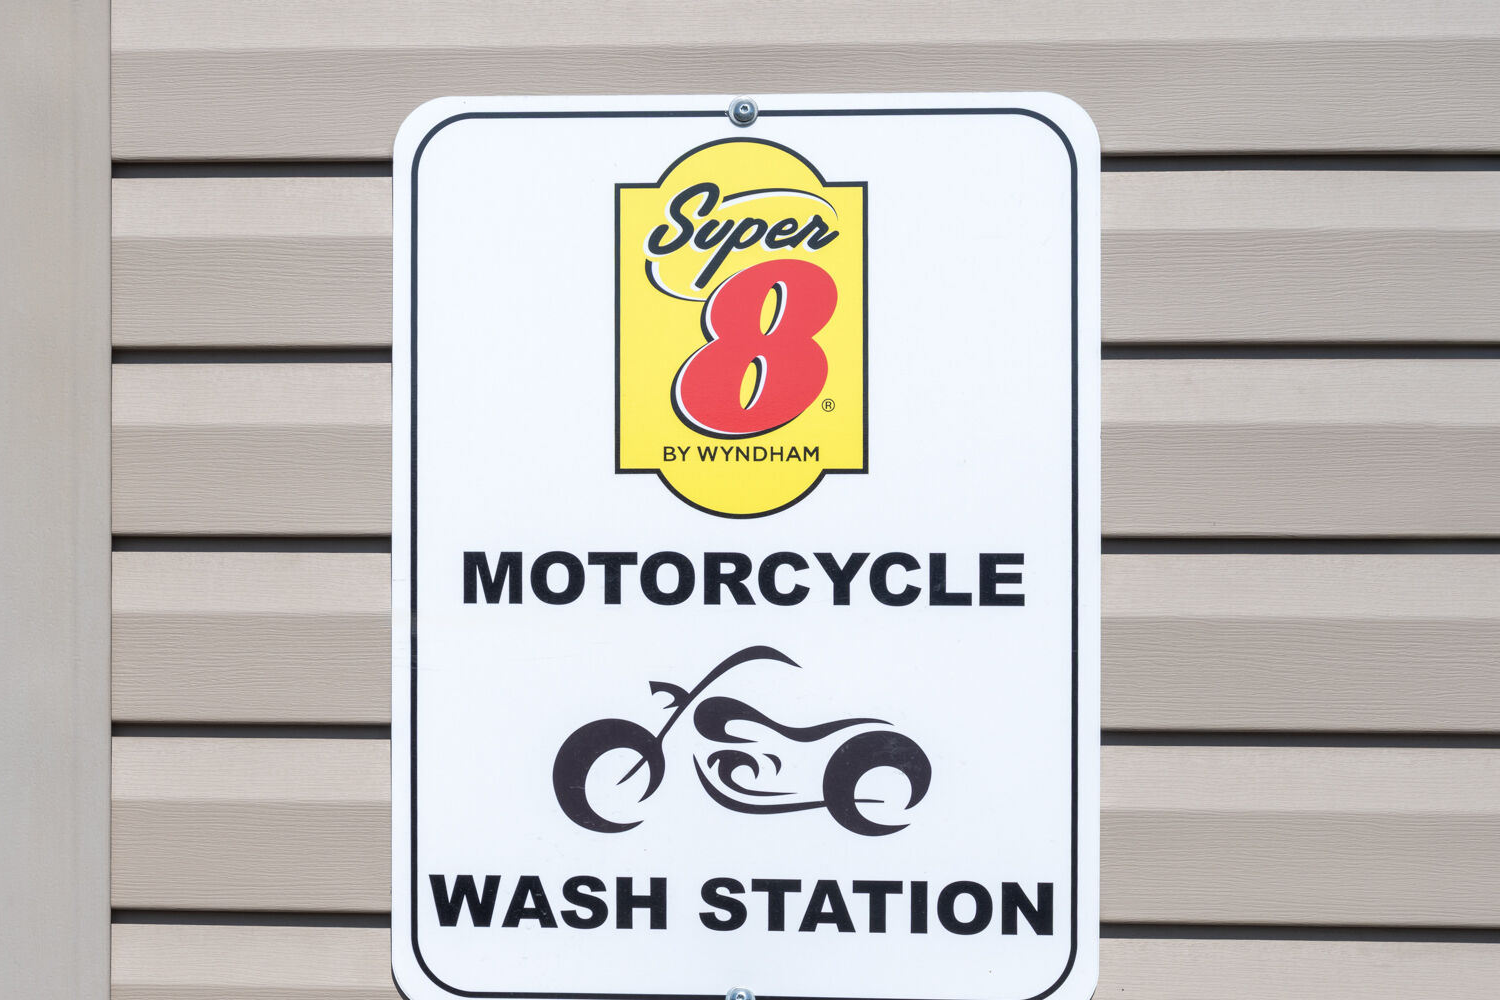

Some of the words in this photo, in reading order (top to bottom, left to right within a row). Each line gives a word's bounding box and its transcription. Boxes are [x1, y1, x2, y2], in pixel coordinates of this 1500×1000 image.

[645, 181, 840, 290] Super
[670, 258, 839, 440] 8
[662, 446, 691, 462] BY
[696, 446, 820, 462] WYNDHAM
[463, 550, 1025, 607] MOTORCYCLE
[428, 874, 667, 930] WASH
[698, 877, 1054, 936] STATION
